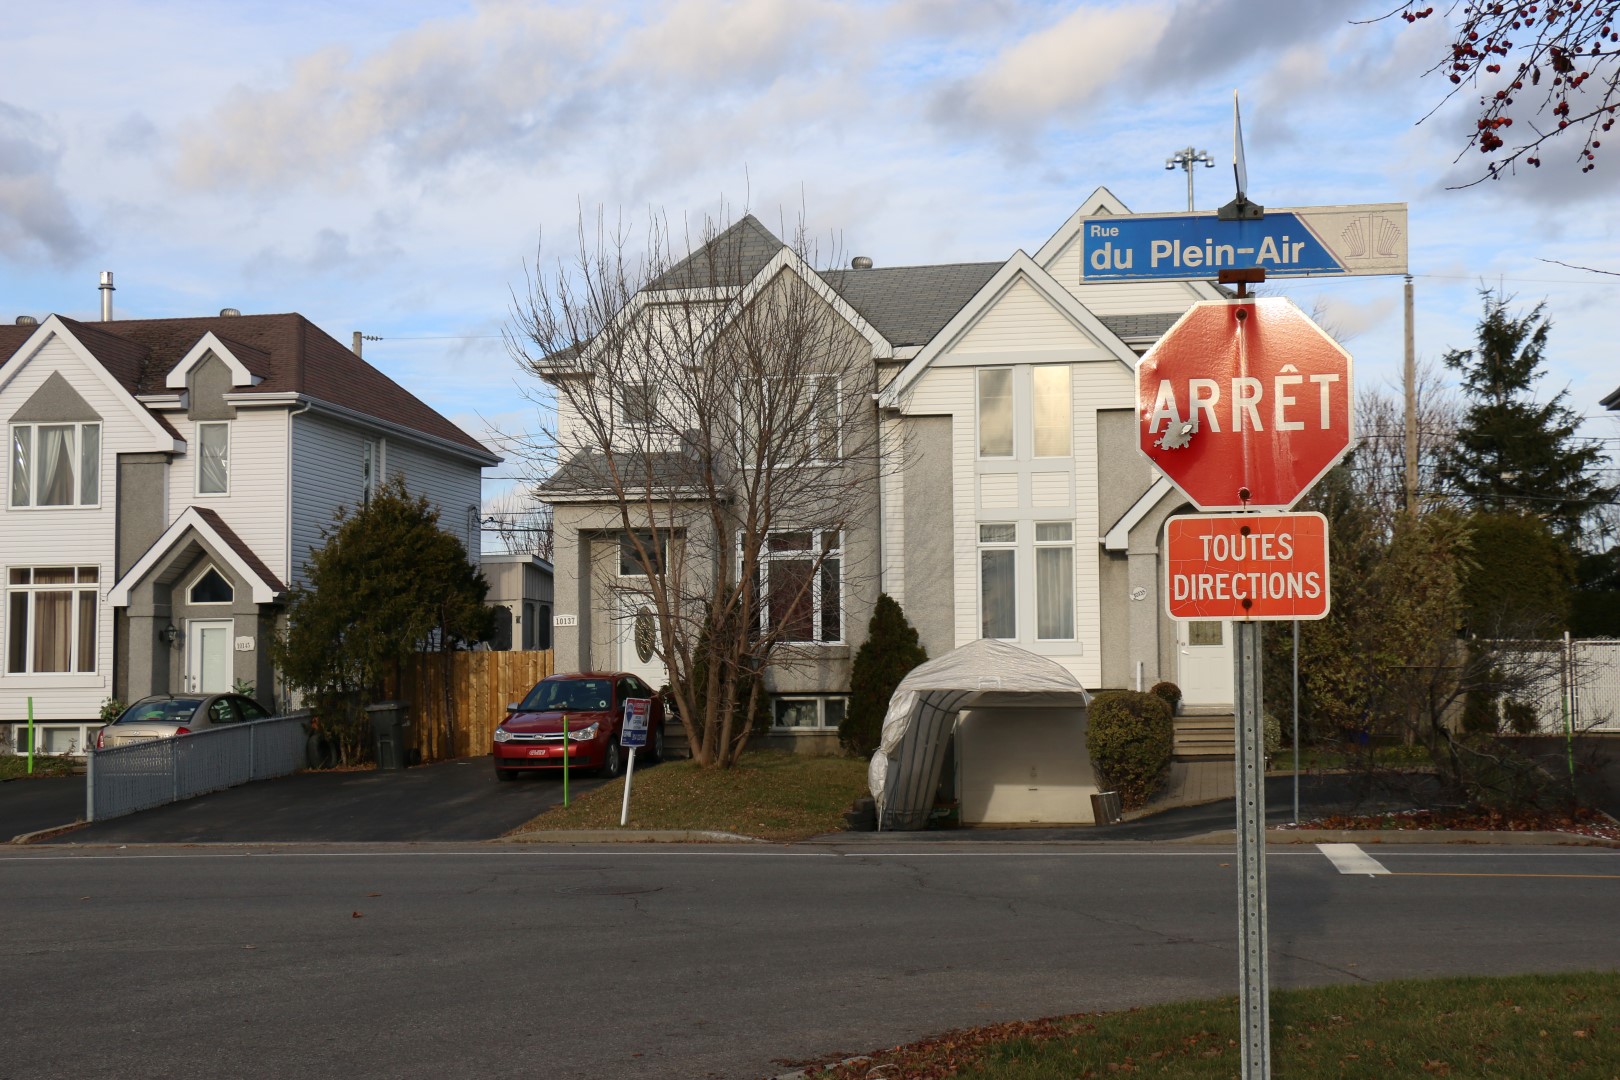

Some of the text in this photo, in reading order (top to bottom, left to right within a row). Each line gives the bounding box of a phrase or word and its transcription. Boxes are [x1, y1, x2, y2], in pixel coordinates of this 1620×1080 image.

[1090, 225, 1119, 237] Rue
[1090, 235, 1305, 269] du Plein-Air
[1149, 364, 1339, 434] ARRÊT
[1199, 533, 1293, 561] TOUTES
[1174, 572, 1320, 601] DIRECTIONS
[556, 617, 576, 625] 10137
